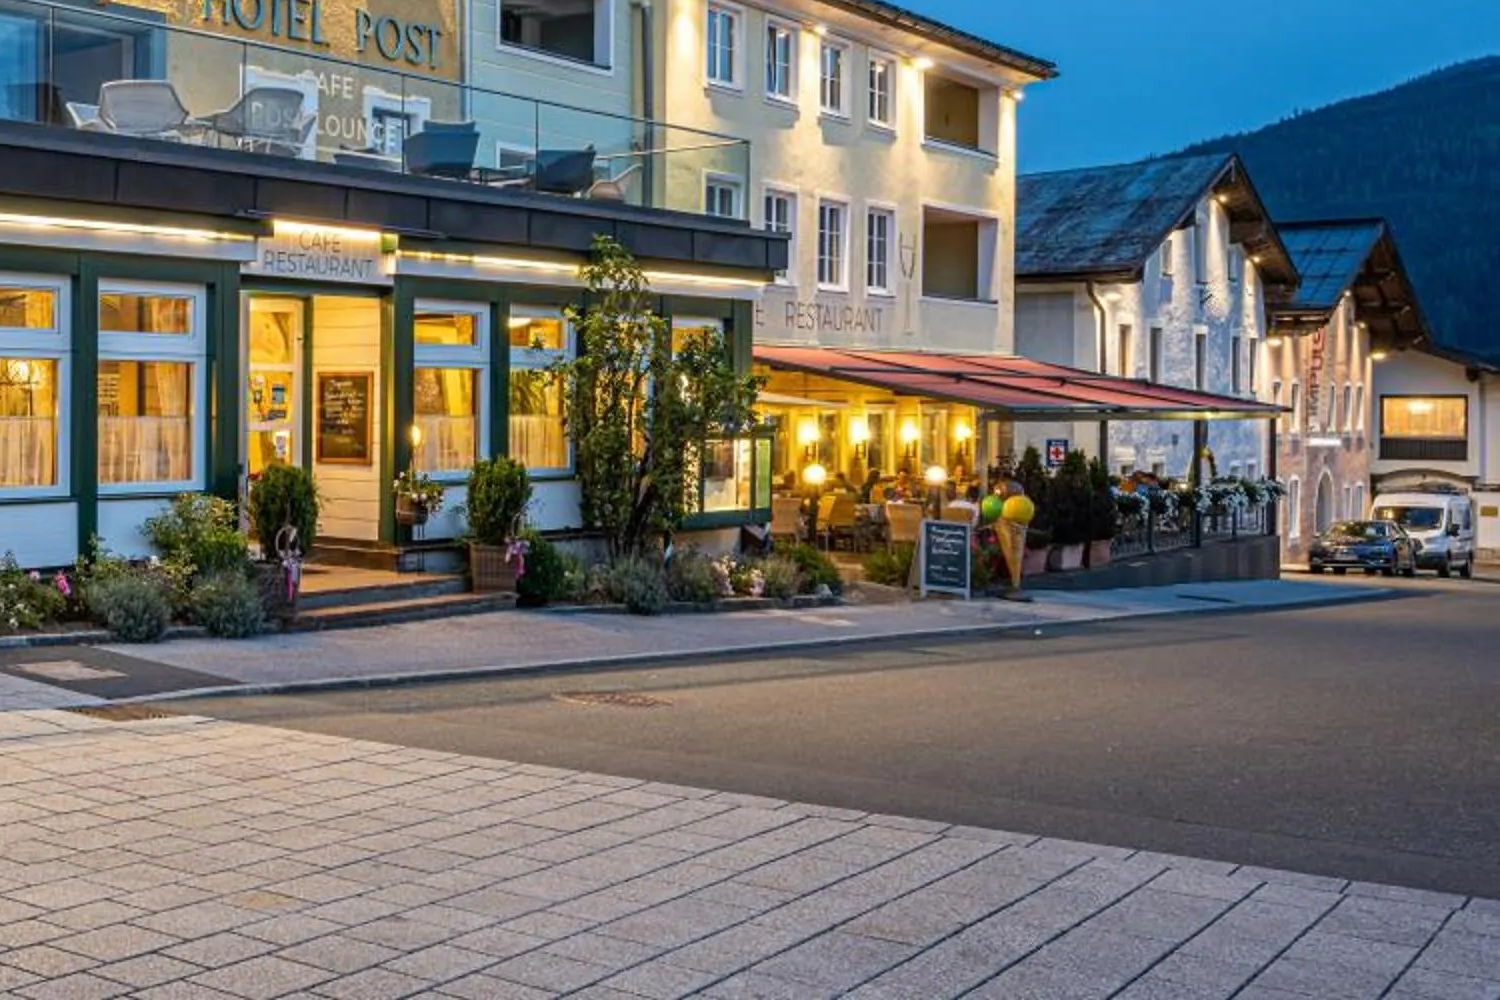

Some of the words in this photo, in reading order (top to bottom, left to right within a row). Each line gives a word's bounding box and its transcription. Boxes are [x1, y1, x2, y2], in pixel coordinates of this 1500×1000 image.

[356, 8, 442, 70] POST
[299, 230, 341, 253] CAFE
[263, 250, 373, 278] RESTAURANT
[785, 301, 882, 332] RESTAURANT
